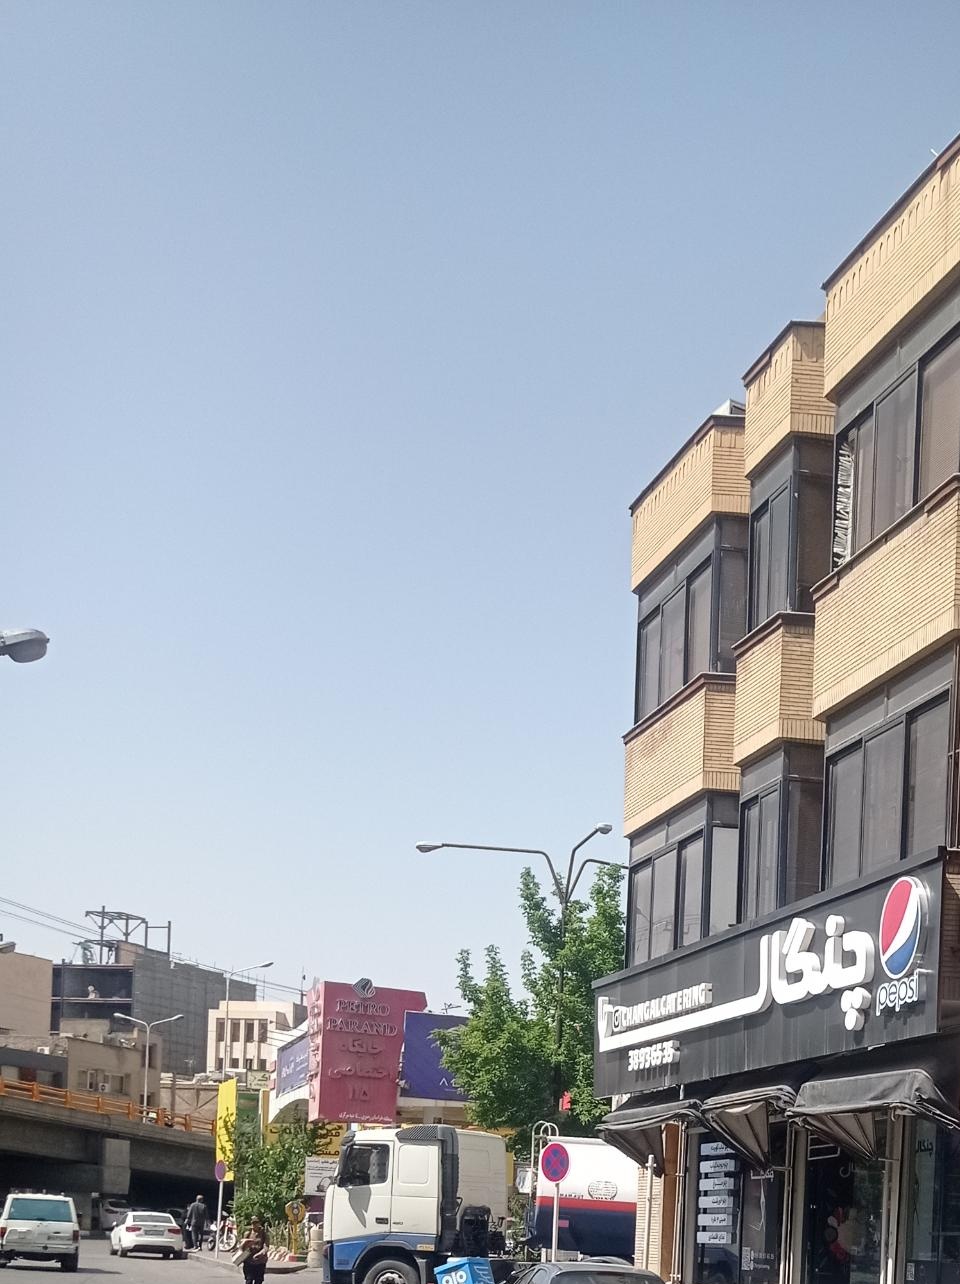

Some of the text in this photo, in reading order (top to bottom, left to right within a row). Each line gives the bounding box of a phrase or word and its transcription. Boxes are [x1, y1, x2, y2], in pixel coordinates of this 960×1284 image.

[876, 969, 919, 1017] pepsi
[335, 999, 391, 1017] PETRO
[326, 1016, 398, 1036] PARAND
[341, 1039, 384, 1058] جایگاه
